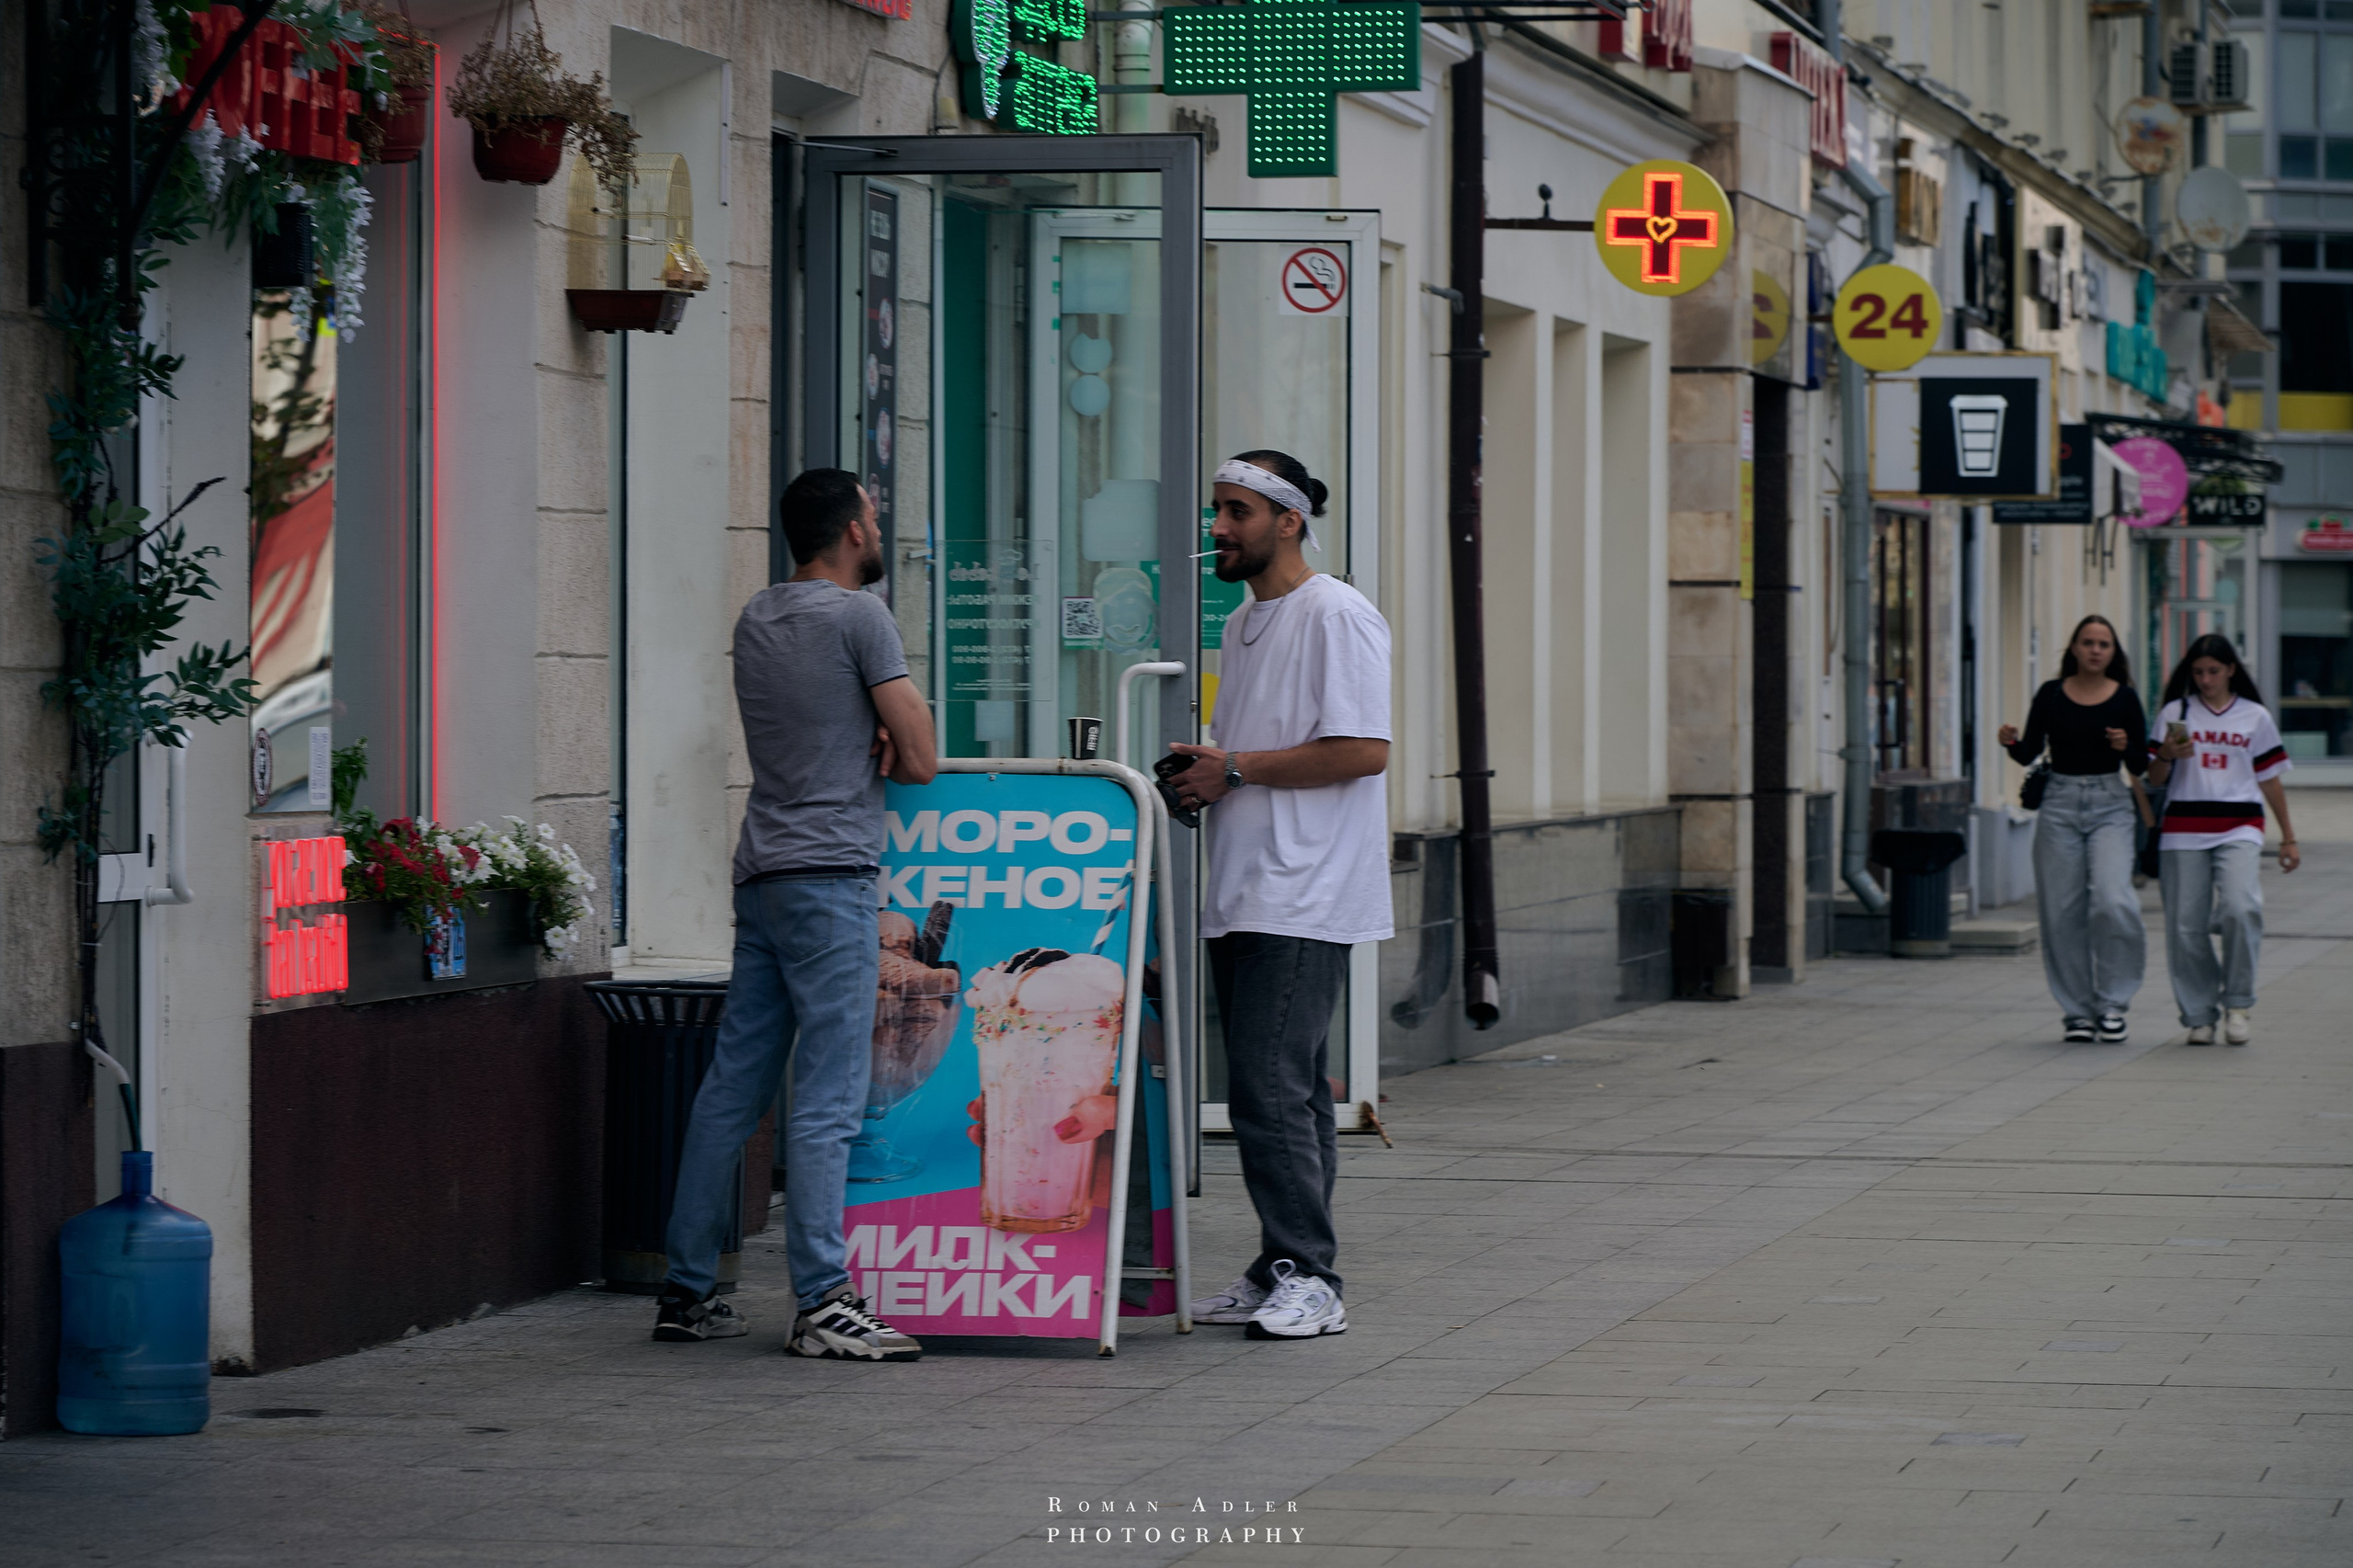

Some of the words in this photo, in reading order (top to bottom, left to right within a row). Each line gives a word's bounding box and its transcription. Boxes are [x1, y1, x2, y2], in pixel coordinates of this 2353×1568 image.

[1848, 293, 1929, 339] 24
[2192, 495, 2262, 516] WILD
[2192, 731, 2251, 748] ANAD
[882, 809, 1132, 855] МОРО-
